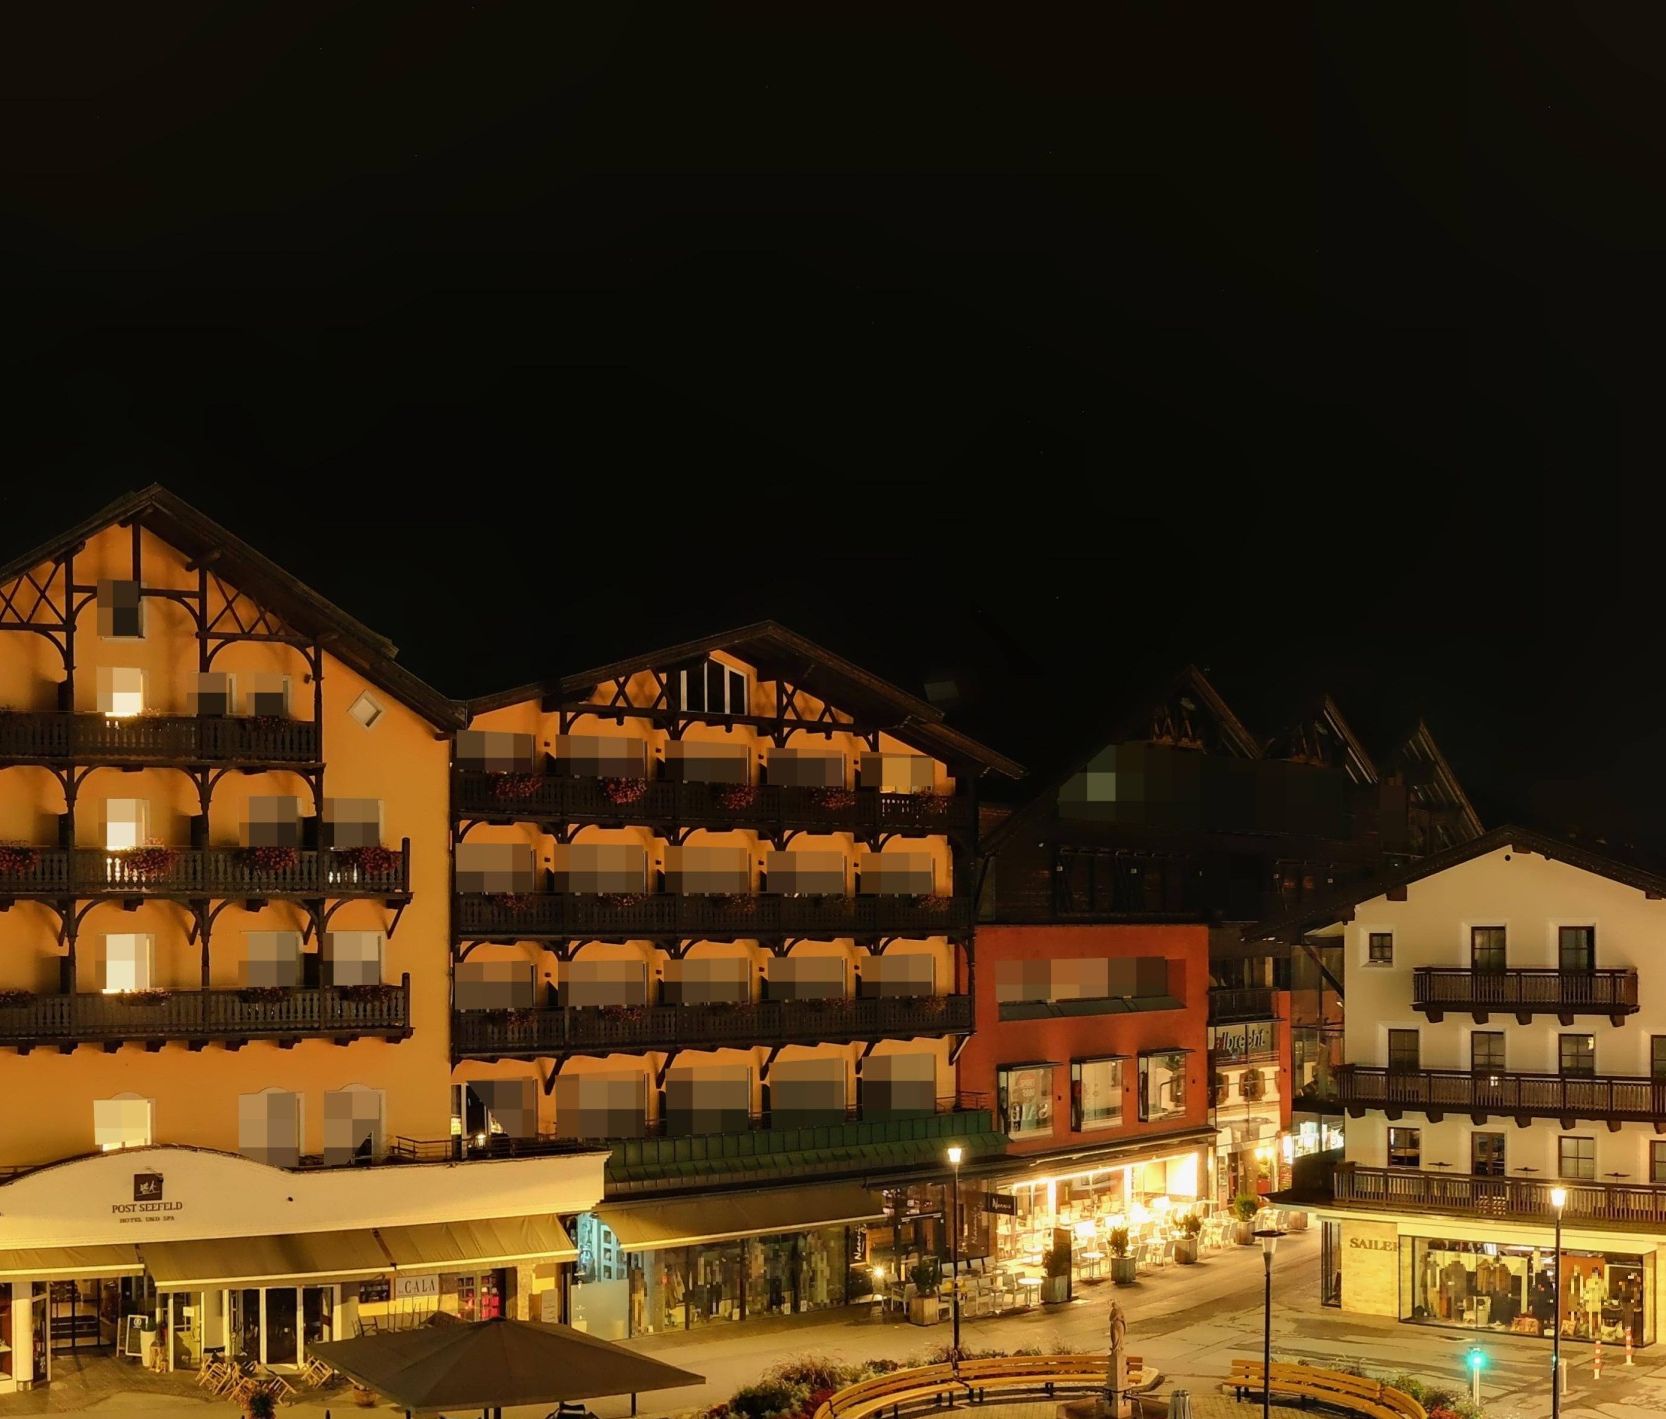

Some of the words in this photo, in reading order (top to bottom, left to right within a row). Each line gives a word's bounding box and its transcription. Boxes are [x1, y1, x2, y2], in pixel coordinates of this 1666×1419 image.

[111, 1203, 137, 1214] POST
[139, 1201, 183, 1213] SEEFELD
[404, 1278, 436, 1295] CALA
